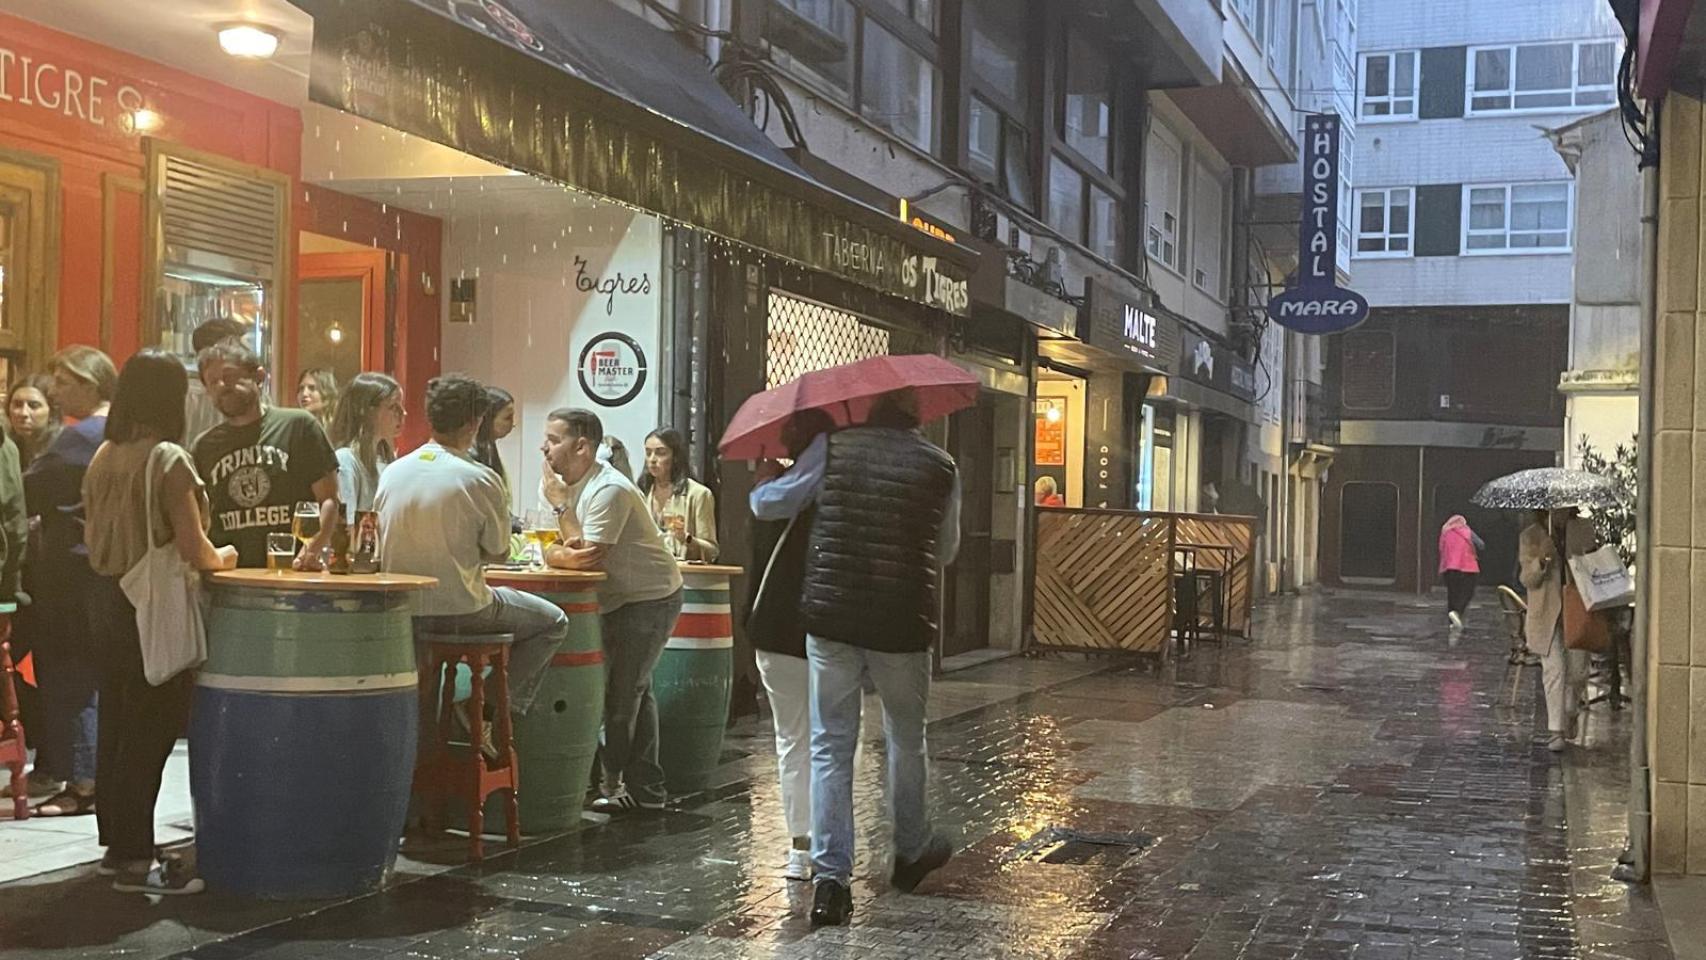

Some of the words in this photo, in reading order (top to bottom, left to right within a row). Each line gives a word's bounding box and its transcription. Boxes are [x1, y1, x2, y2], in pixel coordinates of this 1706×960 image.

[1310, 133, 1330, 277] HOSTAL
[822, 231, 884, 278] TABERNA
[574, 255, 651, 316] Tigres
[1124, 303, 1156, 348] MALTE
[1279, 300, 1358, 317] MARA
[598, 358, 620, 367] BEER
[598, 367, 634, 376] MASTER
[211, 444, 289, 486] TRINITY
